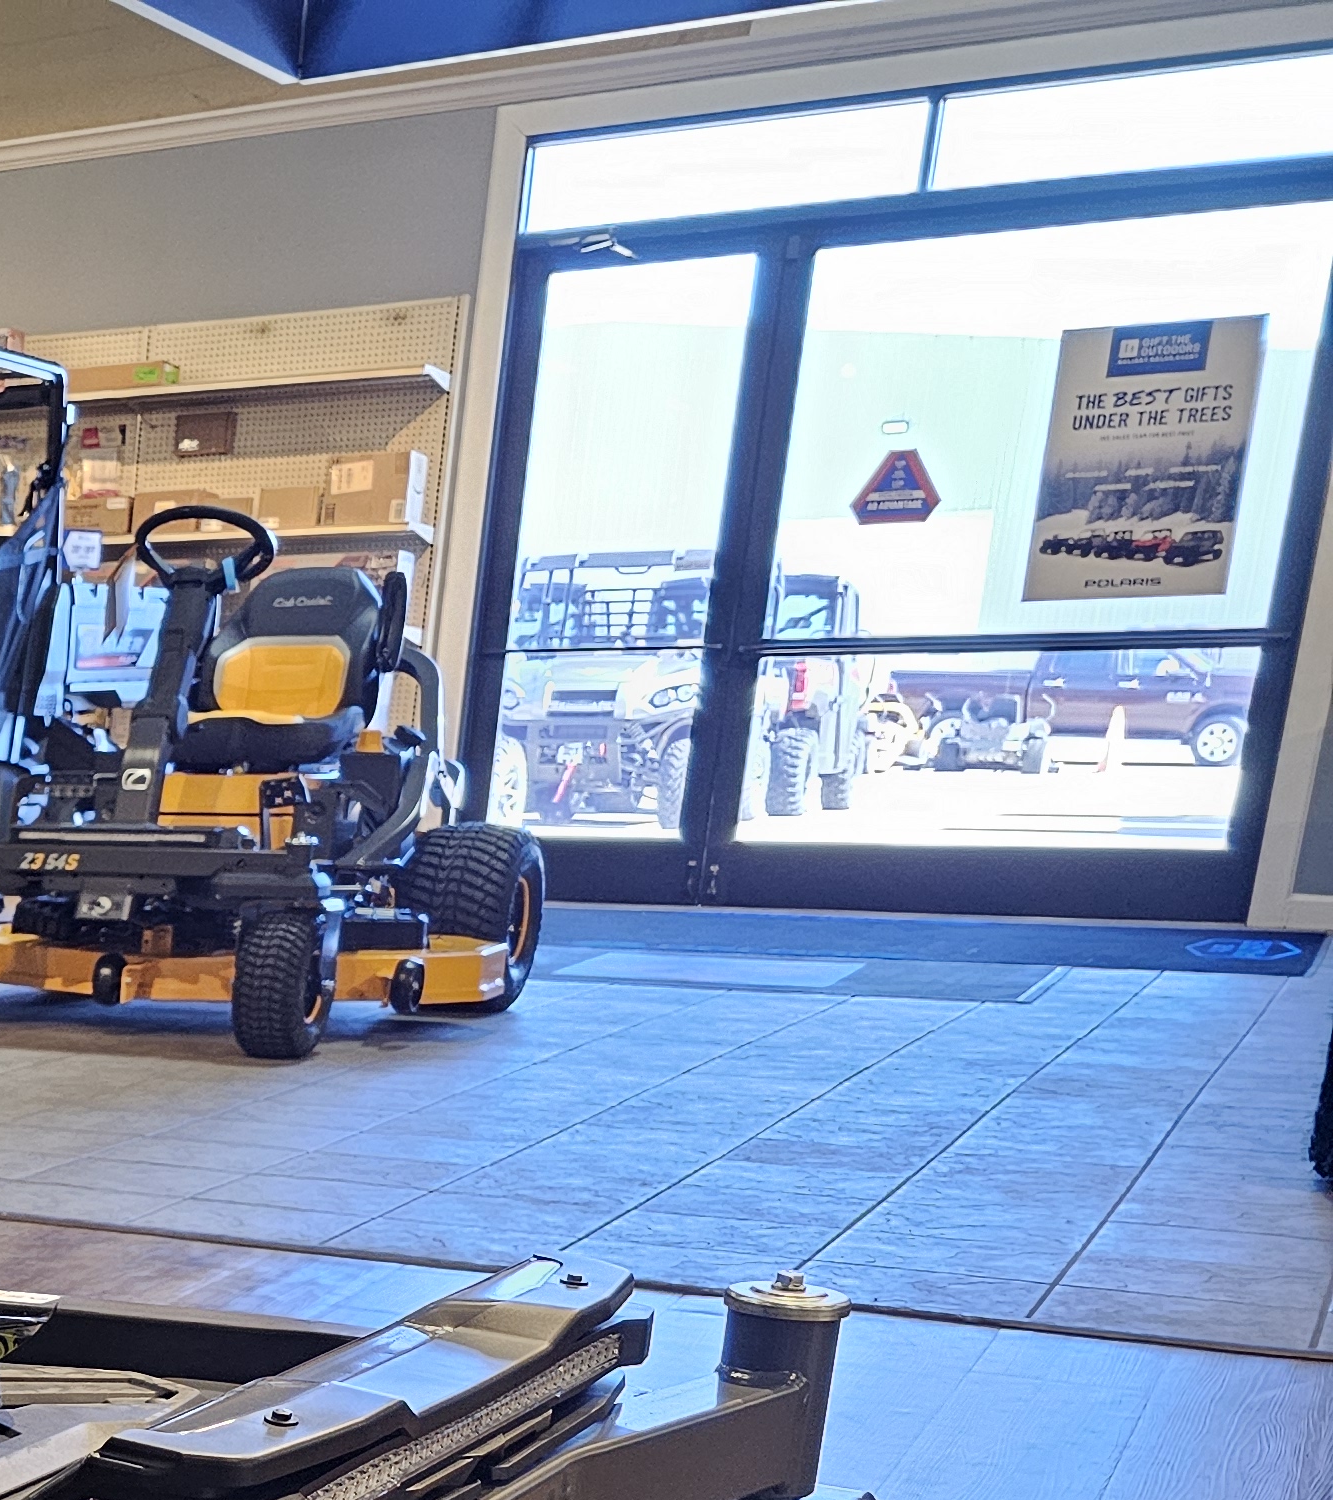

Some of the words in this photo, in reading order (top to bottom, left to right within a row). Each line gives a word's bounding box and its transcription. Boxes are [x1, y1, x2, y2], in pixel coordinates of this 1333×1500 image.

[1076, 393, 1108, 411] THE
[1113, 387, 1183, 408] BEST
[1184, 384, 1234, 404] GIFTS
[1072, 412, 1130, 431] UNDER
[1137, 409, 1171, 426] THE
[1177, 405, 1233, 424] TREES
[1084, 577, 1162, 588] POLARIS
[19, 852, 46, 870] Z3
[44, 853, 81, 871] 54S
